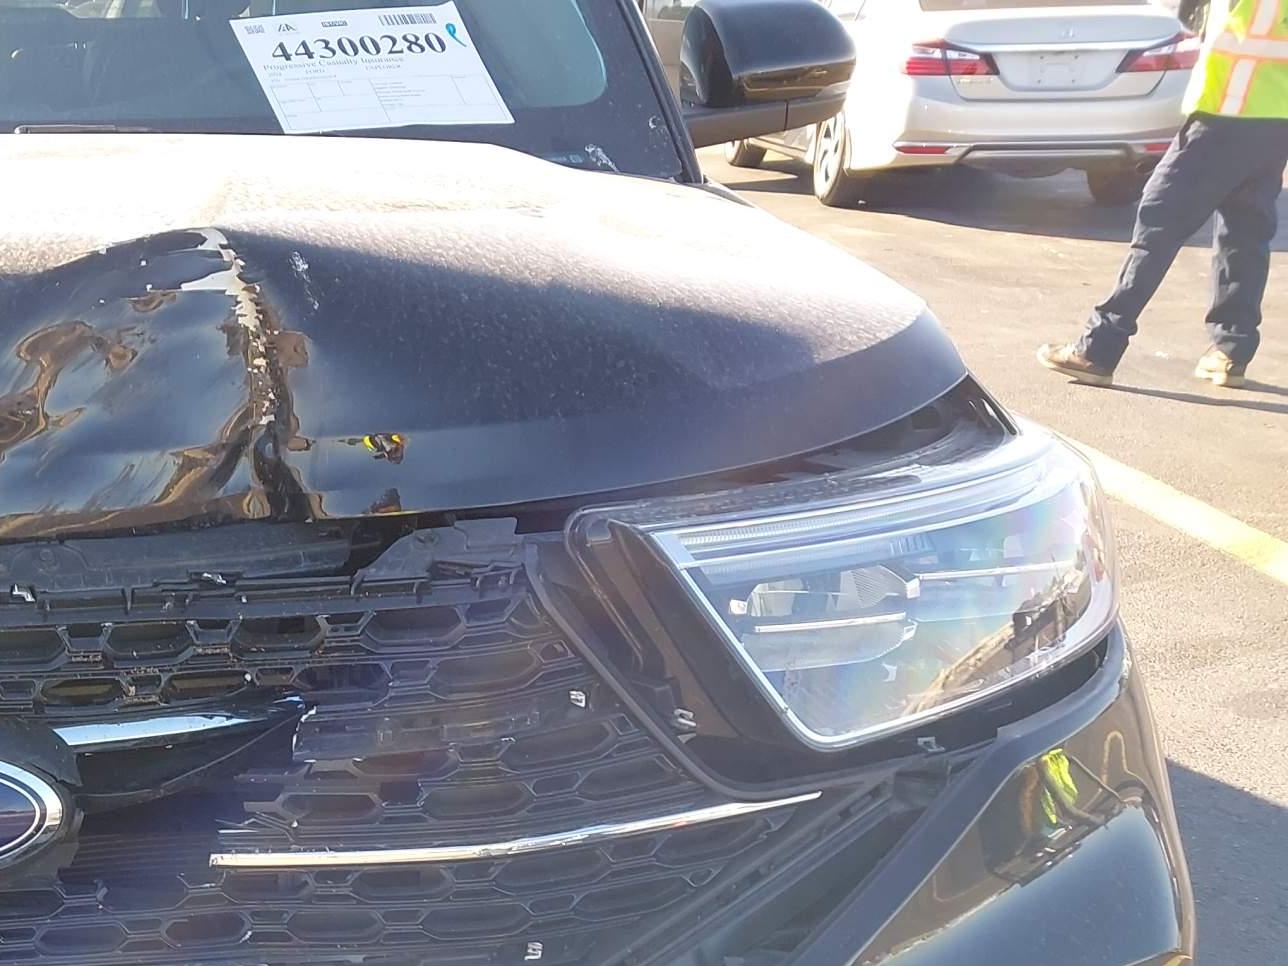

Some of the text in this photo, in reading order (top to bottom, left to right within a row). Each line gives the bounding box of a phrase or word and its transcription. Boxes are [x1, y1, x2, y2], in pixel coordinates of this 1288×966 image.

[272, 32, 447, 61] 44300280
[263, 60, 316, 71] Progressive
[318, 58, 358, 67] Casualty
